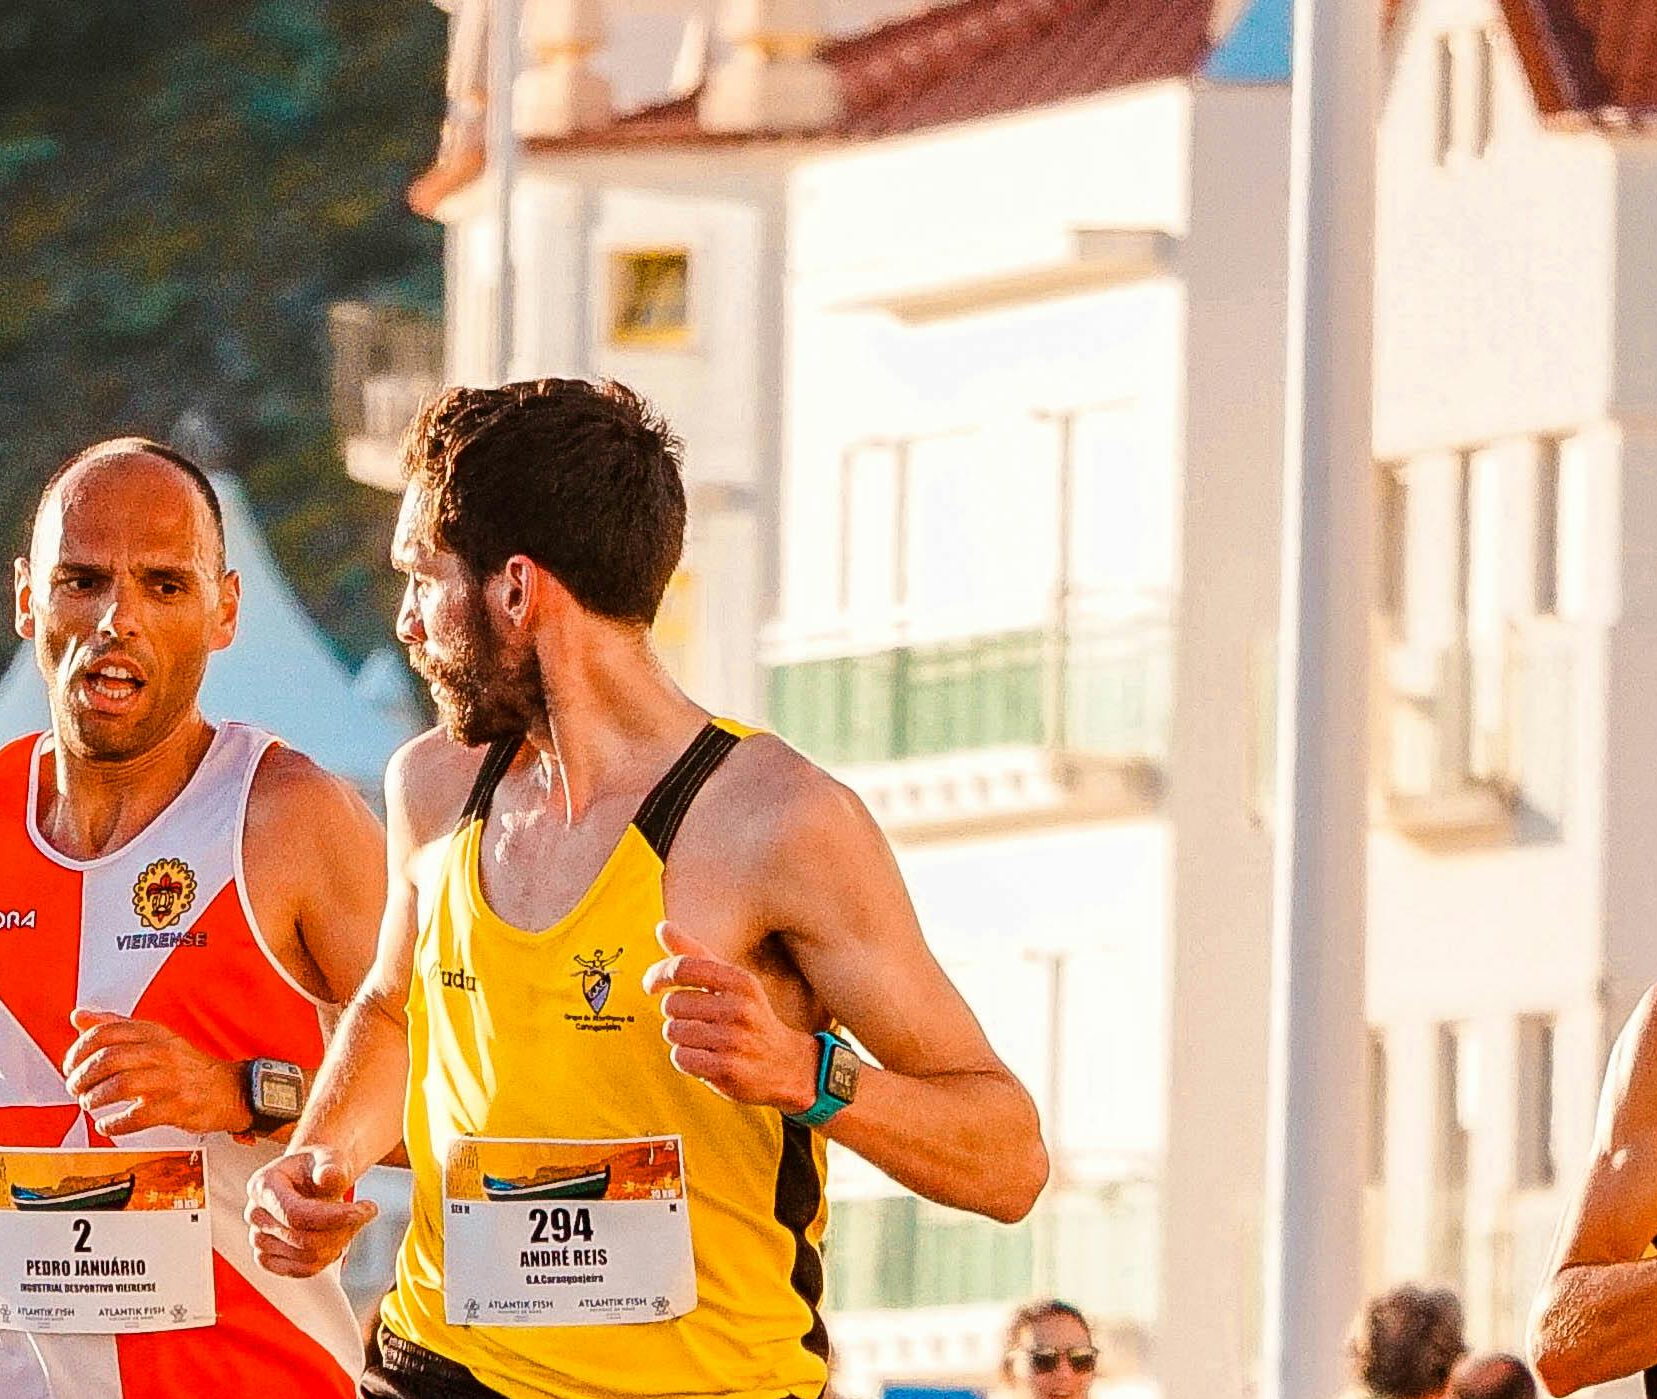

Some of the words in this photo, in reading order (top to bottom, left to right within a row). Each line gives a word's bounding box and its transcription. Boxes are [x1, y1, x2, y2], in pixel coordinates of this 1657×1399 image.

[116, 931, 208, 951] VIEIRENSE
[528, 1208, 594, 1244] 294
[72, 1218, 92, 1253] 2
[520, 1247, 570, 1268] ANDRÉ
[573, 1248, 608, 1267] REIS
[26, 1259, 71, 1277] PEDRO
[74, 1256, 146, 1277] JANUÁRIO
[20, 1283, 63, 1293] INDUSTRIAL
[64, 1283, 114, 1293] DESPORTIVO
[115, 1282, 157, 1293] VIEIRENSE
[488, 1300, 530, 1309] ATLANTIK
[532, 1300, 554, 1309] FISH
[578, 1298, 623, 1308] ATLANTIK
[625, 1297, 647, 1306] FISH
[17, 1307, 53, 1316] ATLANTIK
[55, 1307, 75, 1317] FISH
[98, 1306, 143, 1317] ATLANTIK
[144, 1306, 165, 1315] FISH
